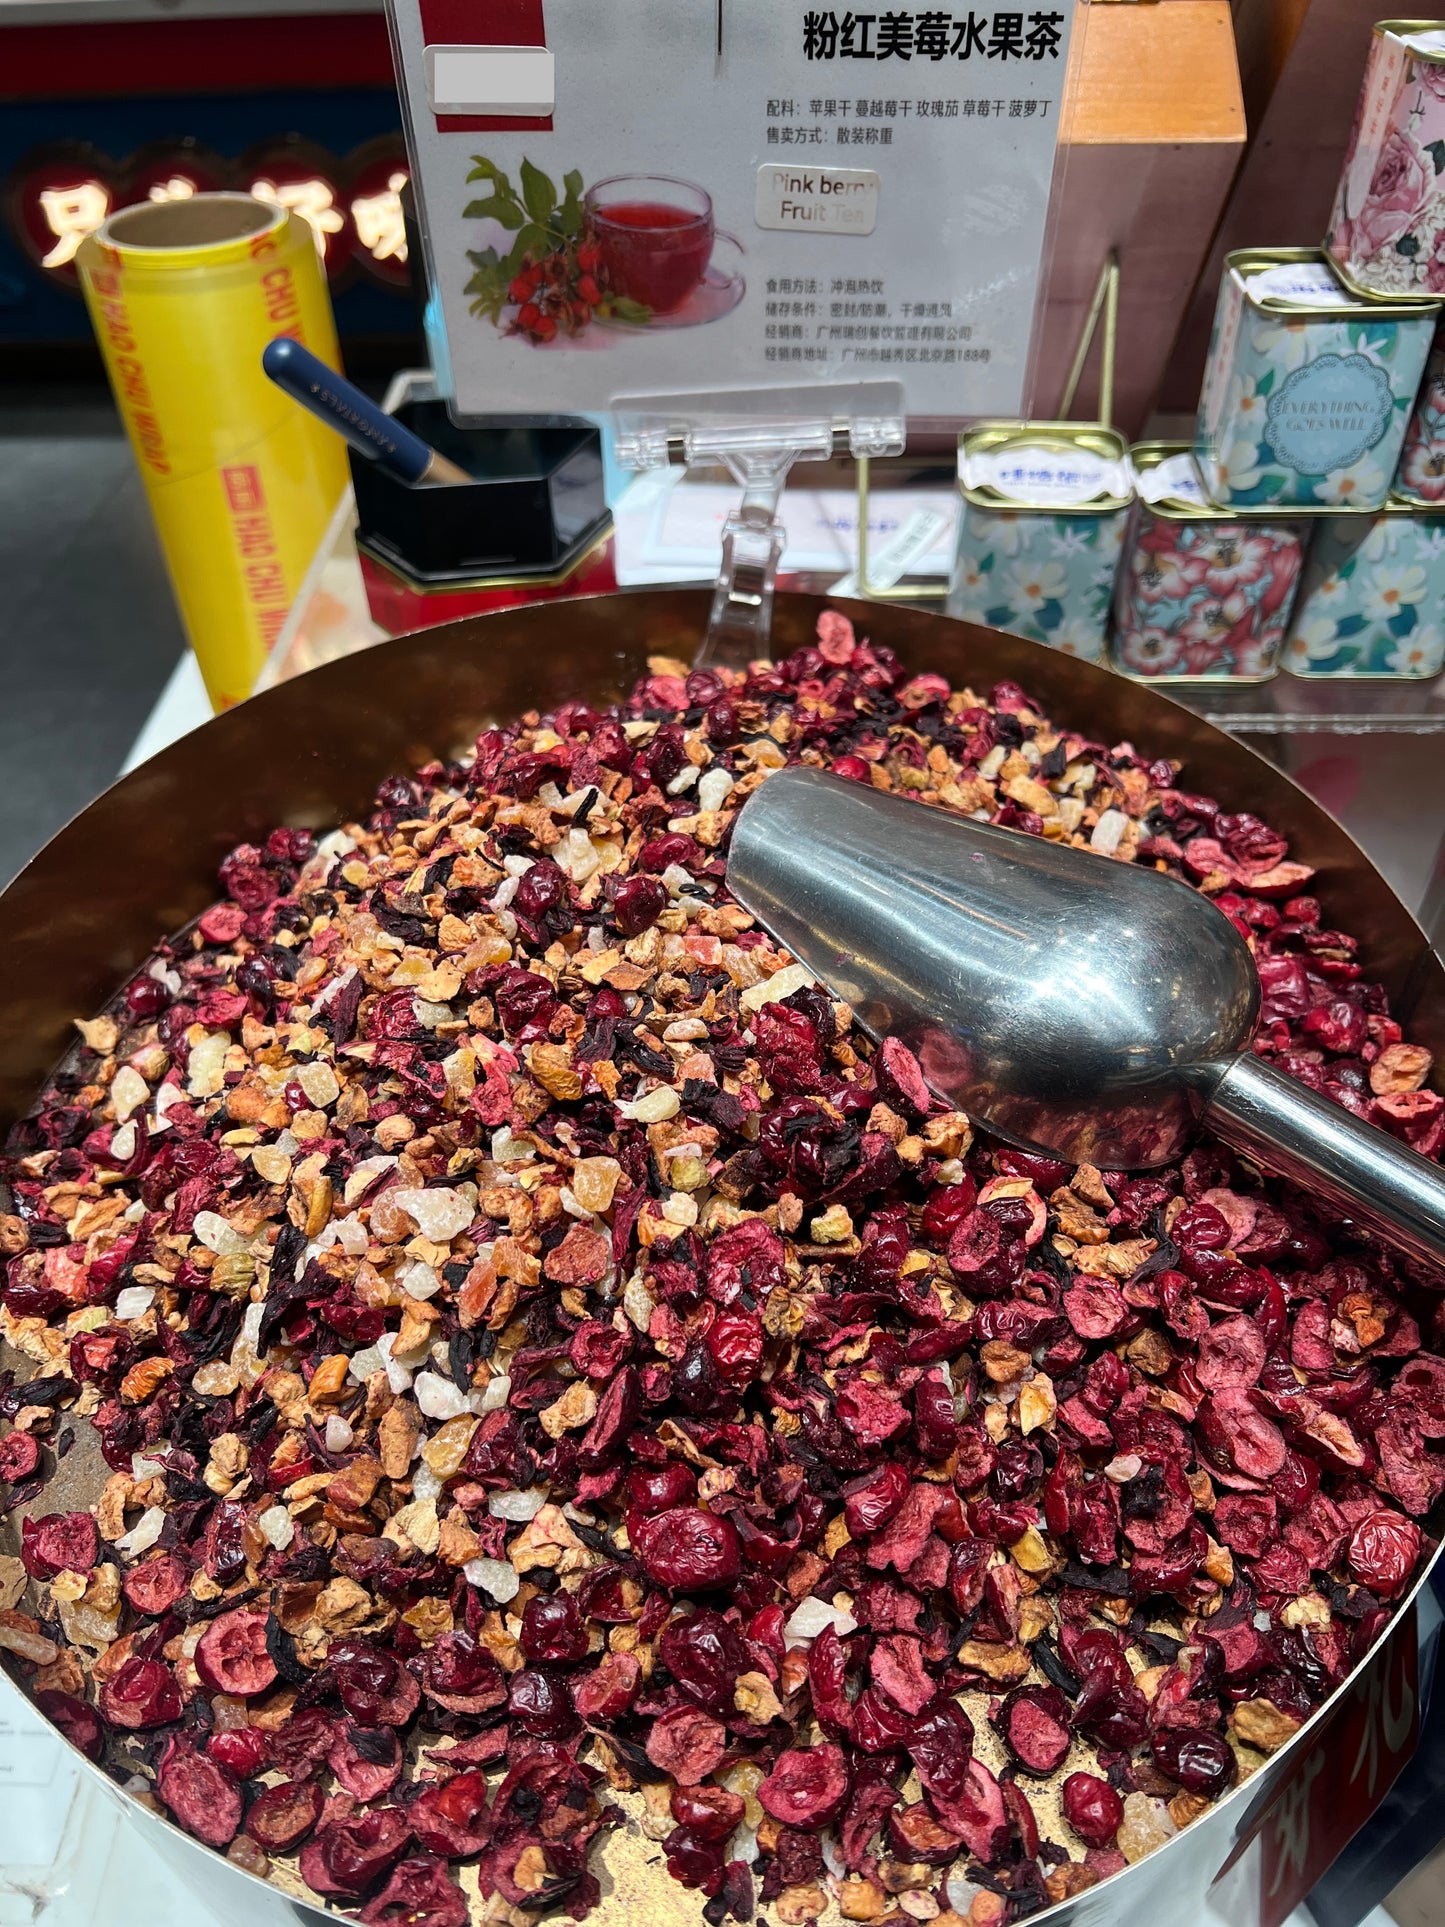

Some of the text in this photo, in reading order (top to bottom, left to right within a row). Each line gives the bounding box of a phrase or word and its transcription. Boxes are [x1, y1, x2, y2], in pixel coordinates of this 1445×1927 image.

[803, 11, 1065, 61] 粉红美莓水果茶
[855, 99, 912, 118] 蔓越莓干
[962, 99, 1005, 118] 草莓干
[772, 173, 814, 194] Pink
[781, 200, 865, 223] Fruit Tea
[262, 267, 301, 322] CHU
